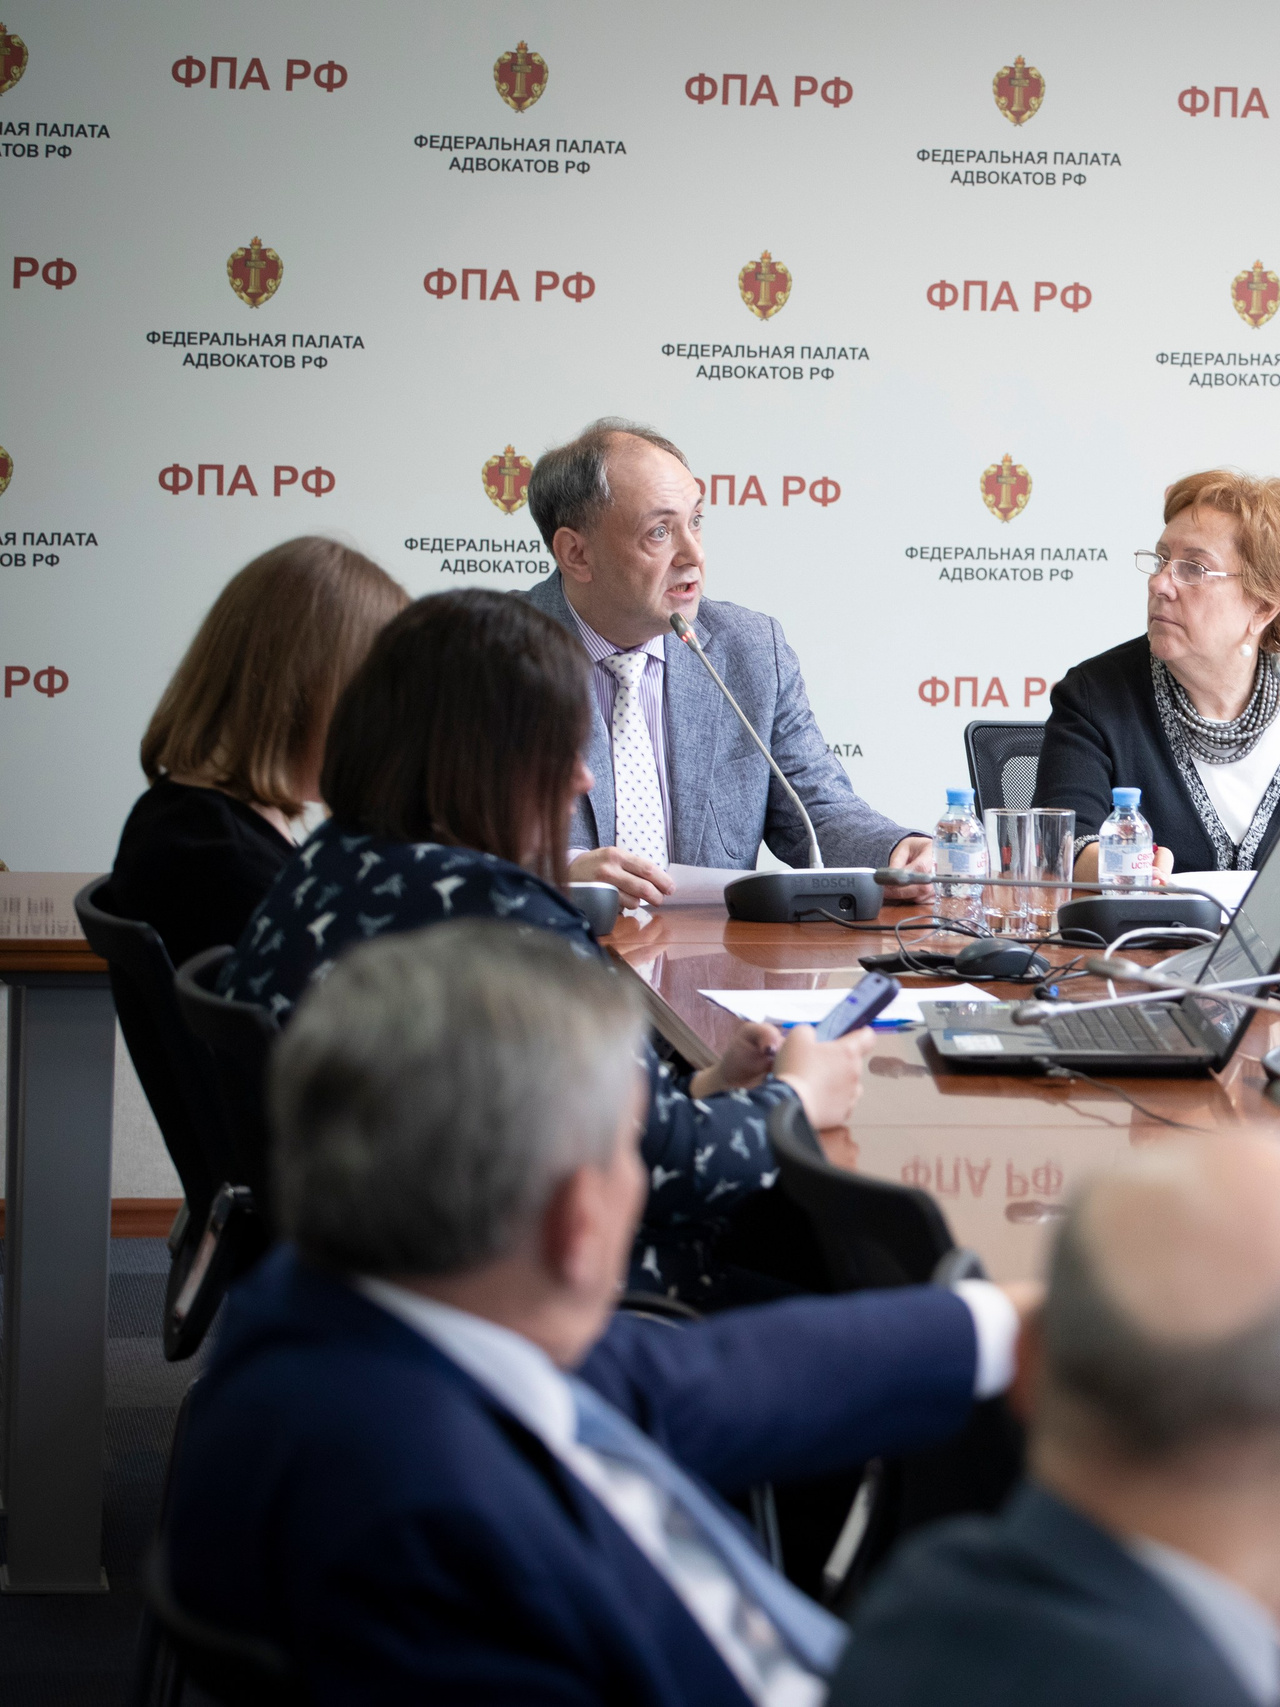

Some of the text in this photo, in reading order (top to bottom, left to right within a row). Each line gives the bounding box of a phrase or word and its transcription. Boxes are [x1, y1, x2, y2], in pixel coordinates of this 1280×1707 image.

[171, 55, 348, 93] ФПА РФ
[684, 72, 854, 109] ФПА РФ
[1177, 85, 1270, 119] ФПА
[0, 121, 111, 139] АЯ ПАЛАТА
[0, 142, 72, 159] ТОВ РФ
[413, 134, 627, 155] ФЕДЕРАЛЬНАЯ ПАЛАТА
[448, 156, 591, 175] АДВОКАТОВ РФ
[916, 148, 1122, 167] ФЕДЕРАЛЬНАЯ ПАЛАТА
[950, 170, 1087, 187] АДВОКАТОВ РФ
[12, 256, 78, 290] РФ
[423, 267, 596, 303] ФПА РФ
[926, 279, 1093, 313] ФПА РФ
[145, 330, 365, 350] ФЕДЕРАЛЬНАЯ ПАЛАТА
[182, 352, 328, 370] АДВОКАТОВ РФ
[661, 343, 870, 361] ФЕДЕРАЛЬНАЯ ПАЛАТА
[695, 364, 835, 381] АДВОКАТОВ РФ
[157, 463, 336, 498] ФПА РФ
[782, 475, 842, 508] РФ
[0, 531, 99, 547] Я ПАЛАТА
[404, 537, 541, 554] ФЕДЕРАЛЬНАЯ
[32, 553, 60, 567] РФ
[904, 546, 1108, 563] ФЕДЕРАЛЬНАЯ ПАЛАТА
[440, 558, 550, 575] АДВОКАТОВ
[938, 567, 1074, 583] АДВОКАТОВ РФ
[4, 665, 69, 699] РФ
[918, 676, 1055, 708] ФПА Р
[826, 743, 864, 757] АТА
[811, 877, 856, 888] BOSCH
